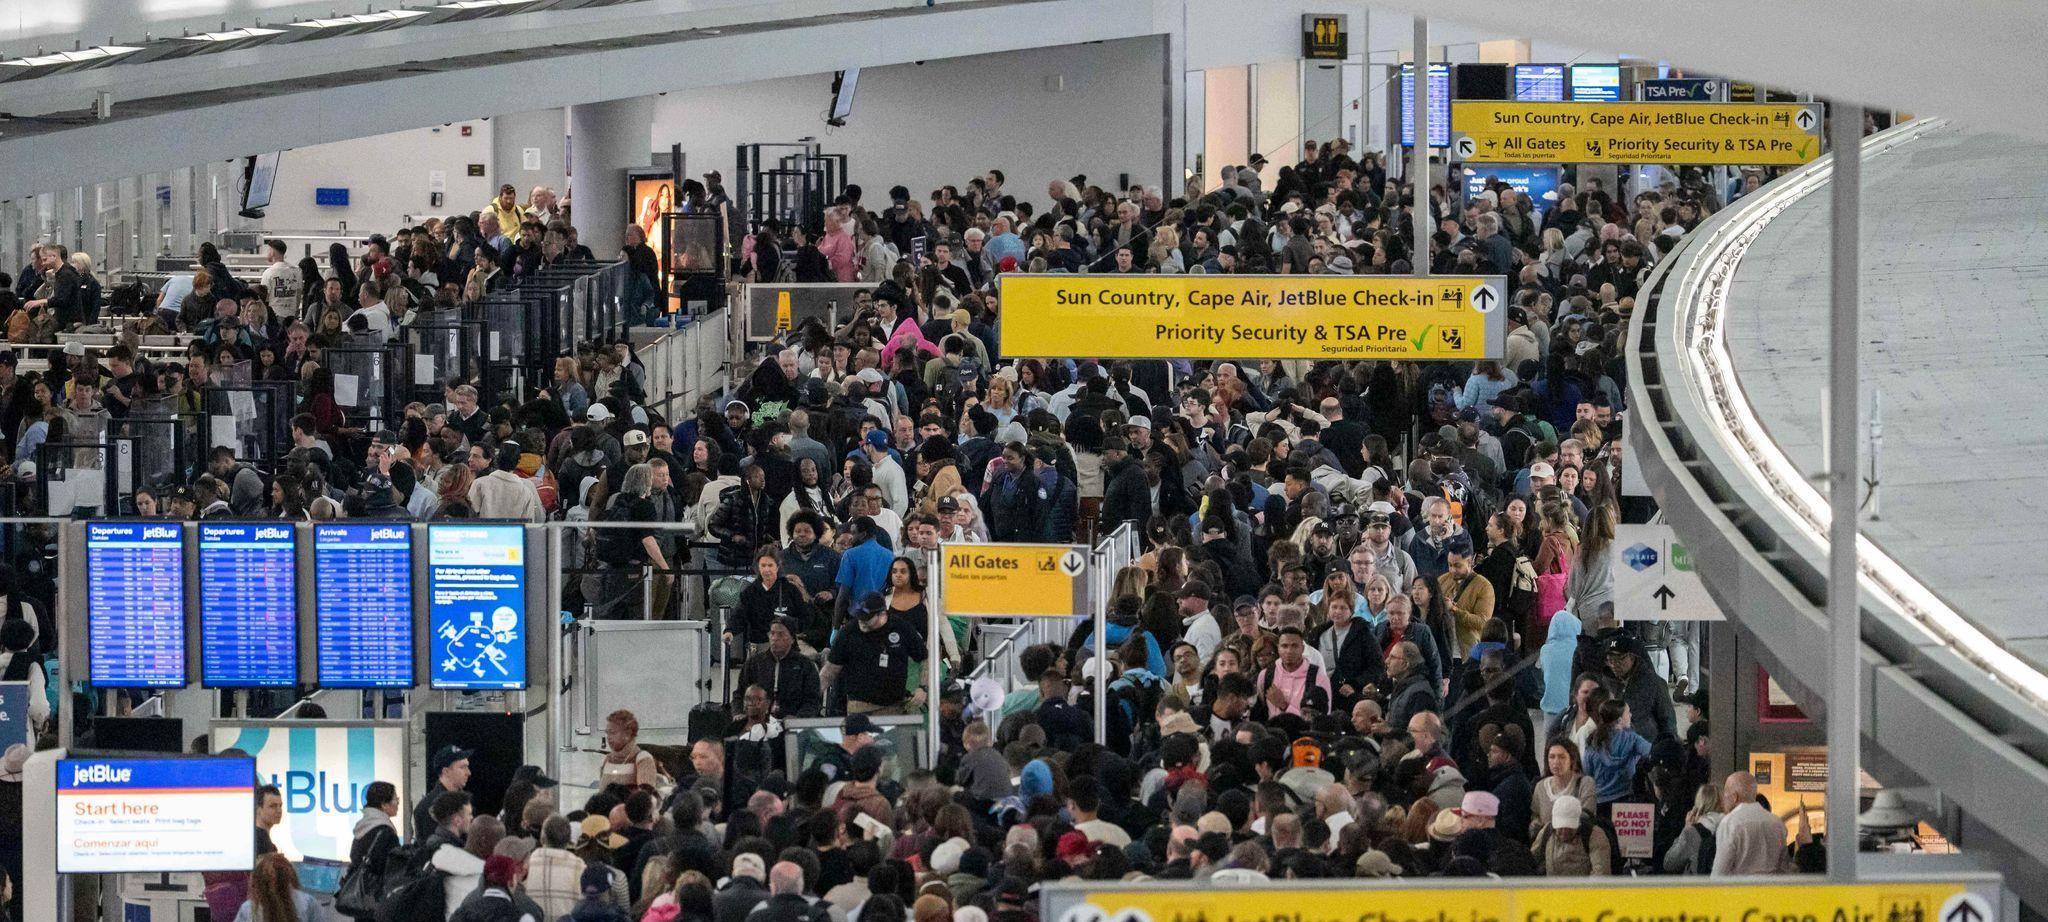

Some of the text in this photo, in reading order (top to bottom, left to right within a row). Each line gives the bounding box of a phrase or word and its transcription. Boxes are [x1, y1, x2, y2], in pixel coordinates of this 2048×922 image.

[1647, 86, 1686, 97] TSA Pre
[1494, 112, 1769, 128] Sun Country, Cape Air, JetBlue Check-in
[1503, 137, 1566, 150] All Gates
[1608, 138, 1793, 154] Priority Security & TSA Pre
[1503, 151, 1522, 159] Todas
[1532, 152, 1556, 160] puertas
[1608, 152, 1672, 160] Seguridad Prioritaria
[1056, 289, 1434, 310] Sun Country, Cape Air, JetBlue Check-in
[1156, 324, 1407, 346] Priority Security & TSA Pre
[1321, 344, 1408, 355] Seguridad Prioritaria
[92, 527, 133, 537] Departures
[143, 527, 178, 540] jetBlue
[204, 527, 246, 537] Departures
[255, 527, 290, 541] jetBlue
[319, 528, 348, 536] Arrivals
[371, 528, 406, 541] jetBlue
[949, 554, 1019, 570] All Gates
[73, 764, 132, 786] jetBlue
[74, 801, 159, 816] Start here
[1616, 811, 1650, 819] PLEASE
[1614, 820, 1651, 828] DO NOT
[73, 838, 131, 849] Comenzar
